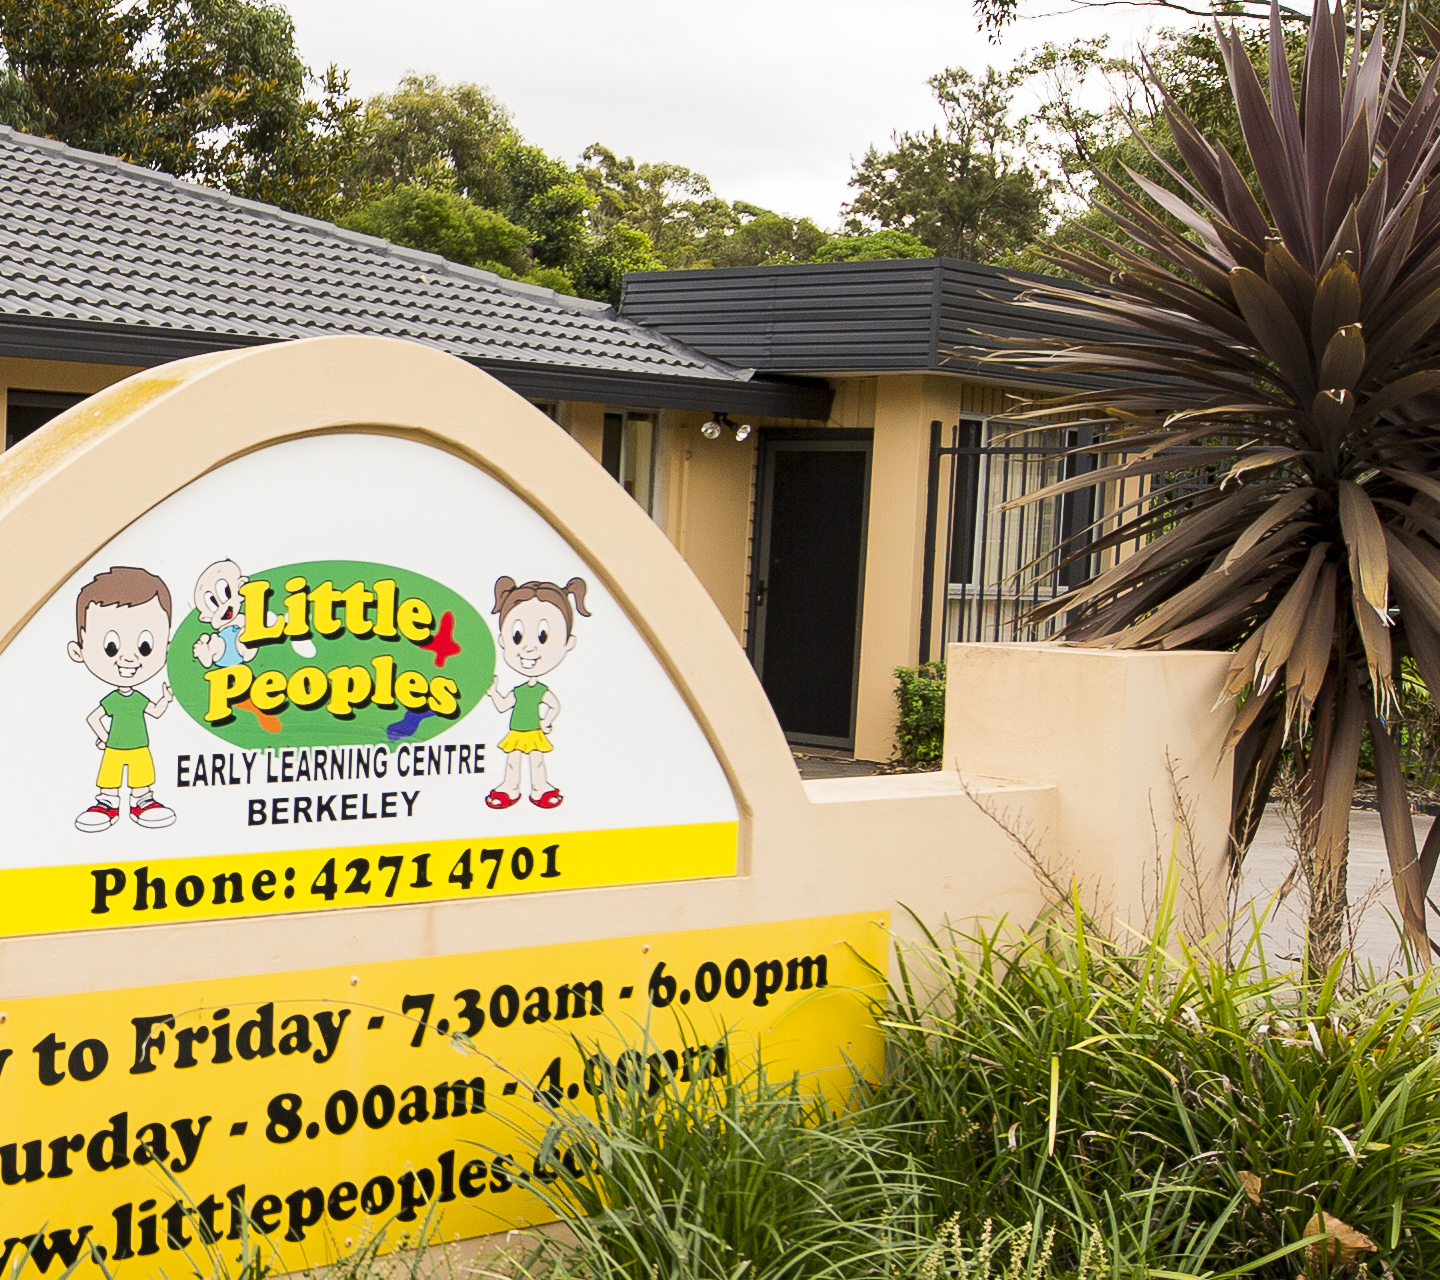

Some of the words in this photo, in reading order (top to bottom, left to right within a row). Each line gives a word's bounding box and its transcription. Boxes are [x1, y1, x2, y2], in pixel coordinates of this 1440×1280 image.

[239, 576, 435, 647] Little
[204, 655, 460, 725] Peoples
[177, 752, 257, 788] EARLY
[266, 747, 388, 784] LEARNING
[397, 743, 486, 777] CENTRE
[247, 790, 421, 827] BERKELEY
[90, 865, 295, 914] Phone:
[310, 853, 432, 901] 4271
[448, 844, 562, 890] 4701
[32, 1033, 109, 1086] to
[129, 1002, 352, 1074] Friday
[402, 980, 604, 1048] 7.30am
[648, 954, 828, 1008] 6.00pm
[265, 1076, 488, 1144] 8.00am
